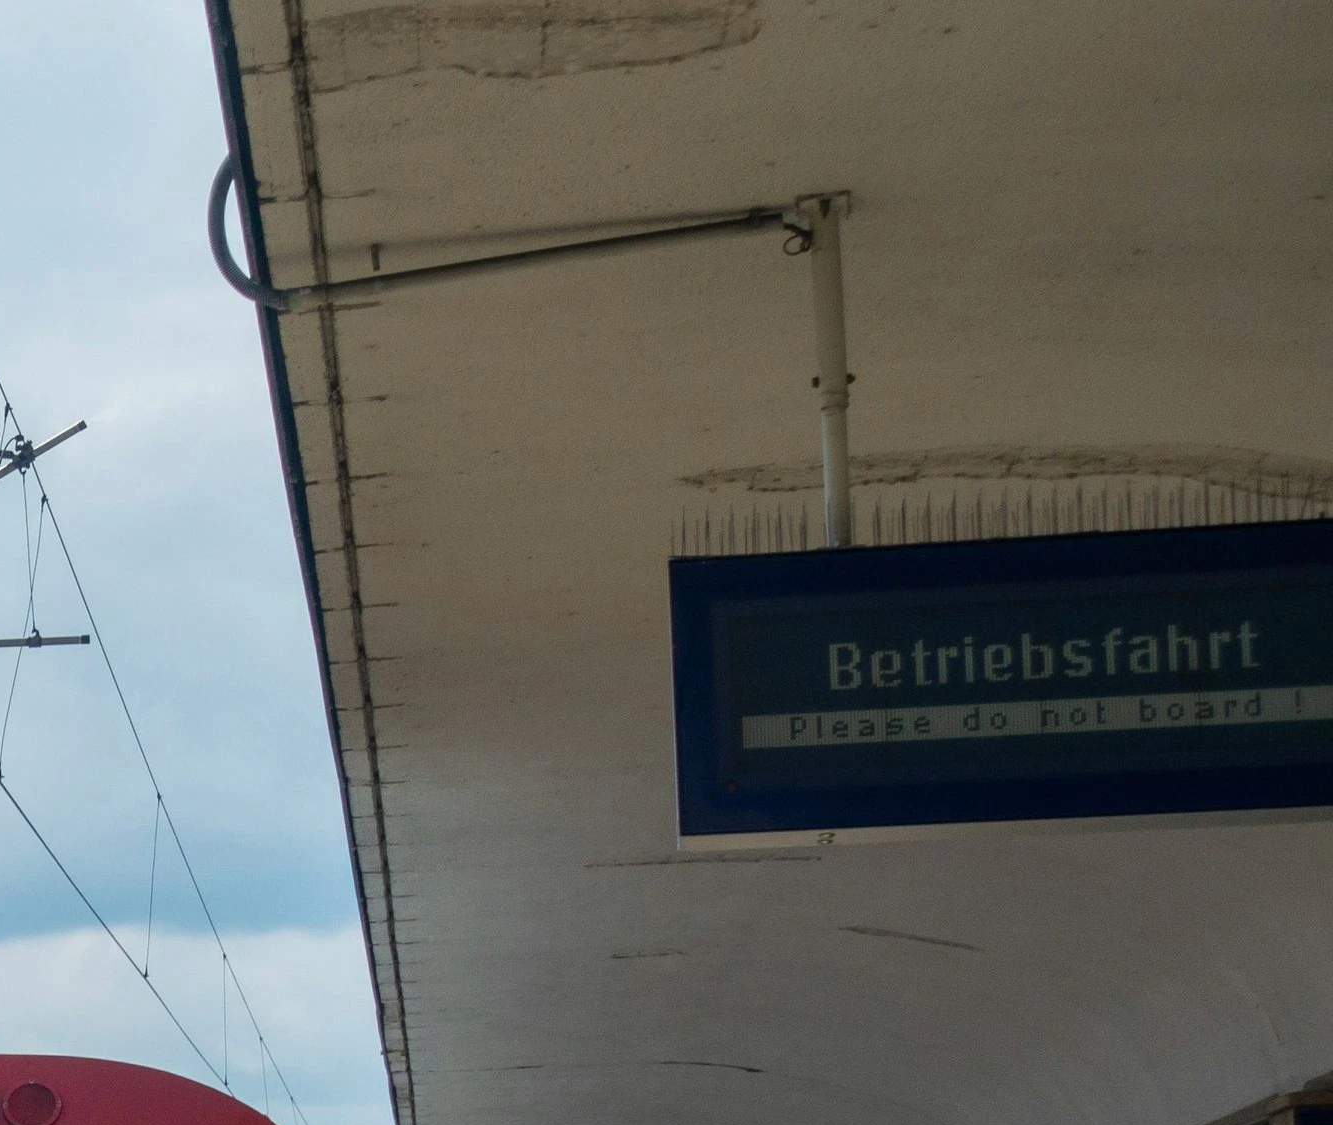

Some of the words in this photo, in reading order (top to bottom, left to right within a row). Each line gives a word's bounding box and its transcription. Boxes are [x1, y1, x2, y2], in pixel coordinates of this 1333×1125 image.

[829, 620, 1261, 691] Betriebsfahrt
[790, 716, 931, 740] Please
[963, 708, 1007, 732] do
[1041, 700, 1107, 728] not
[1139, 691, 1262, 721] board
